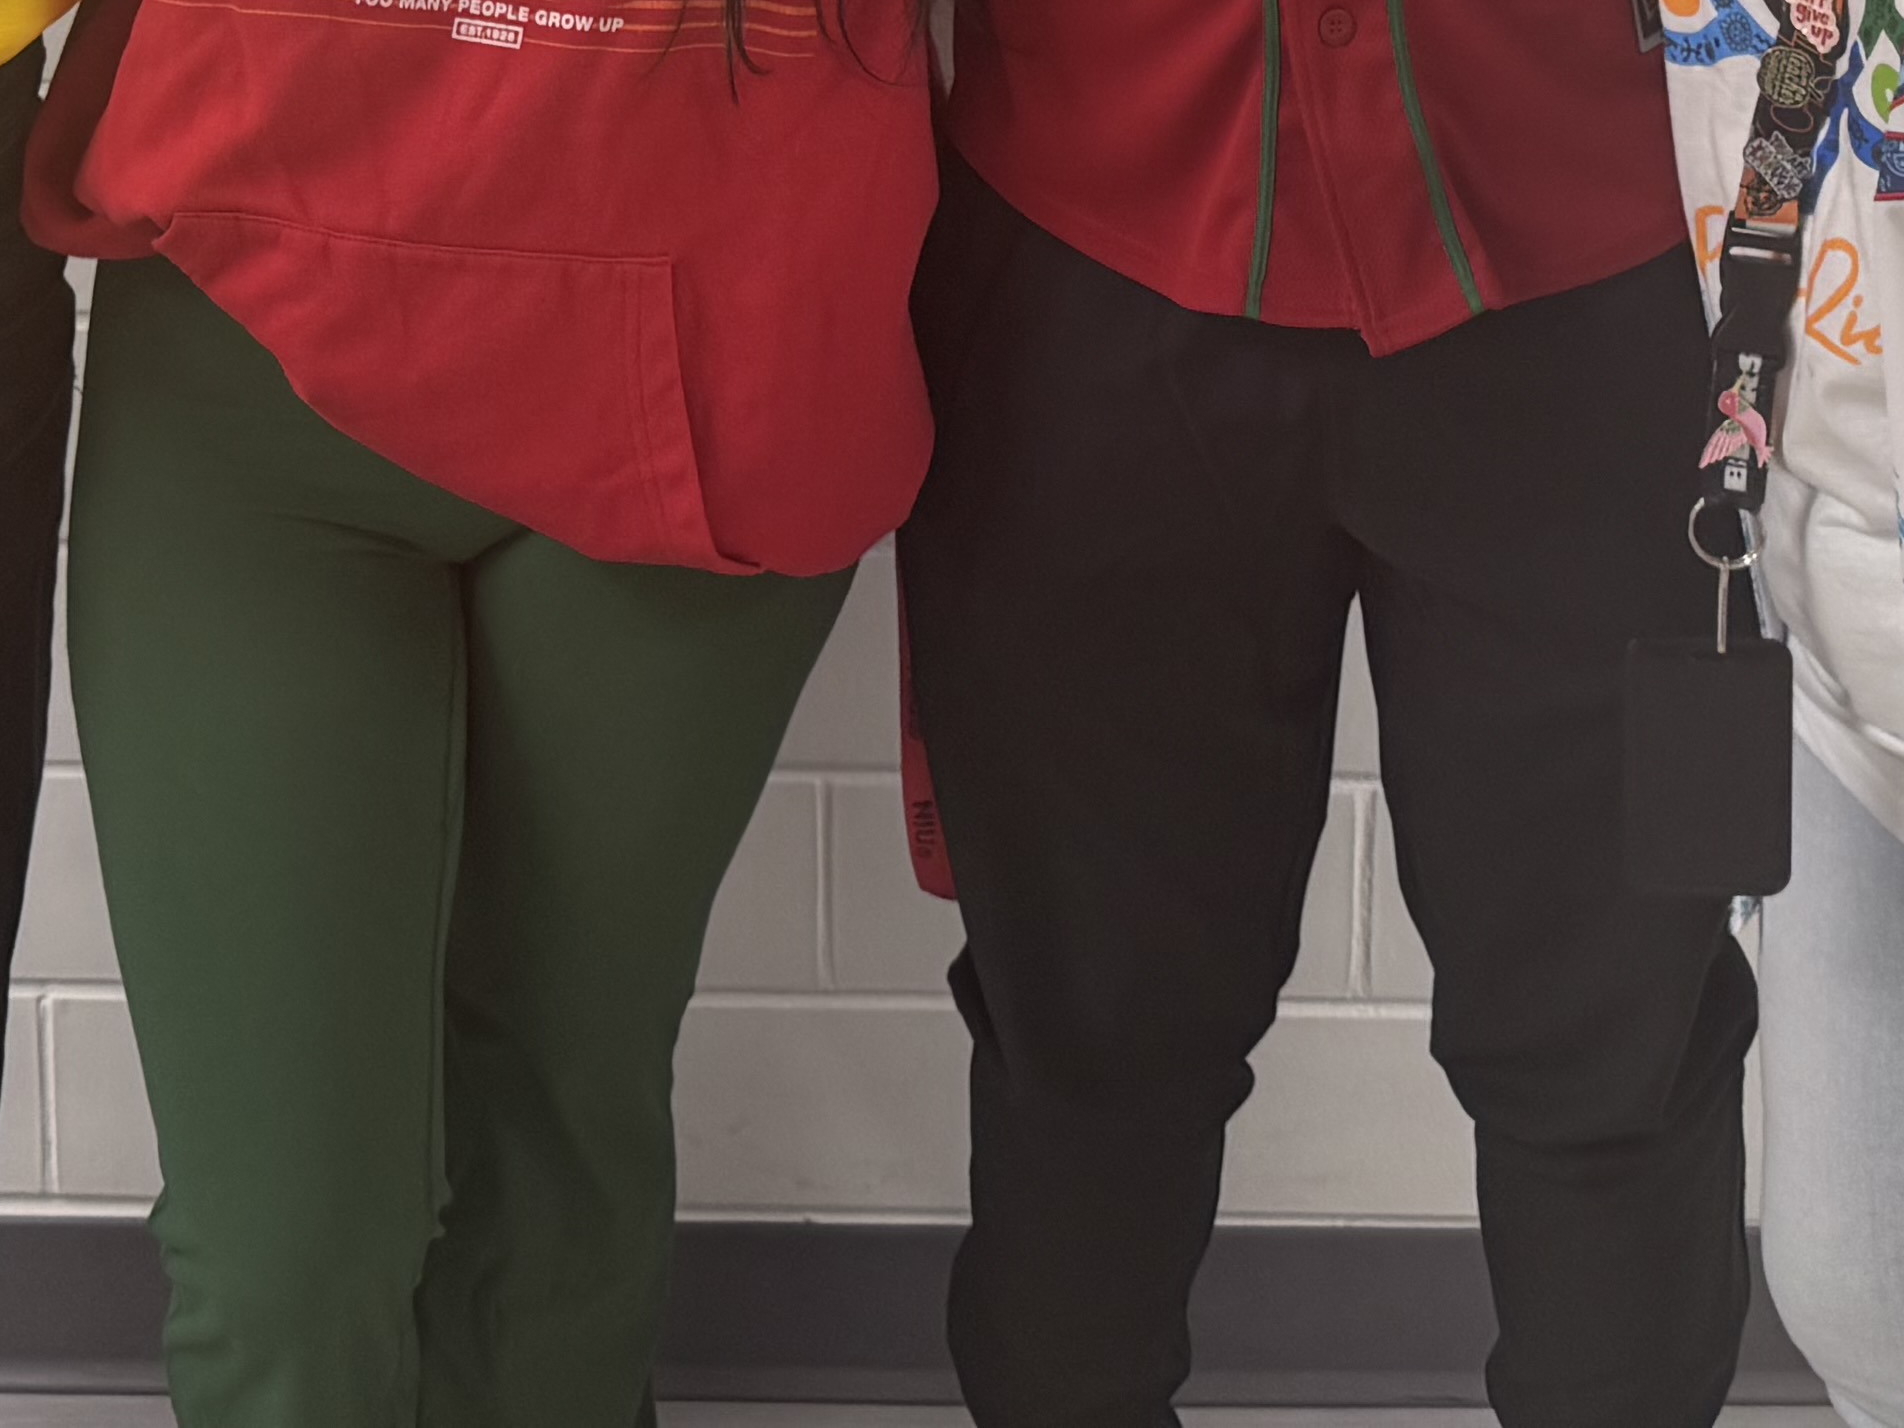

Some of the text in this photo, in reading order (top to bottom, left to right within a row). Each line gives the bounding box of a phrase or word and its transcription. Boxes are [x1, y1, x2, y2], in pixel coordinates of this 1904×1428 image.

[534, 10, 594, 33] GROW
[599, 17, 625, 33] UP
[1795, 3, 1830, 25] give
[1810, 22, 1834, 47] up
[1805, 236, 1884, 366] Ric
